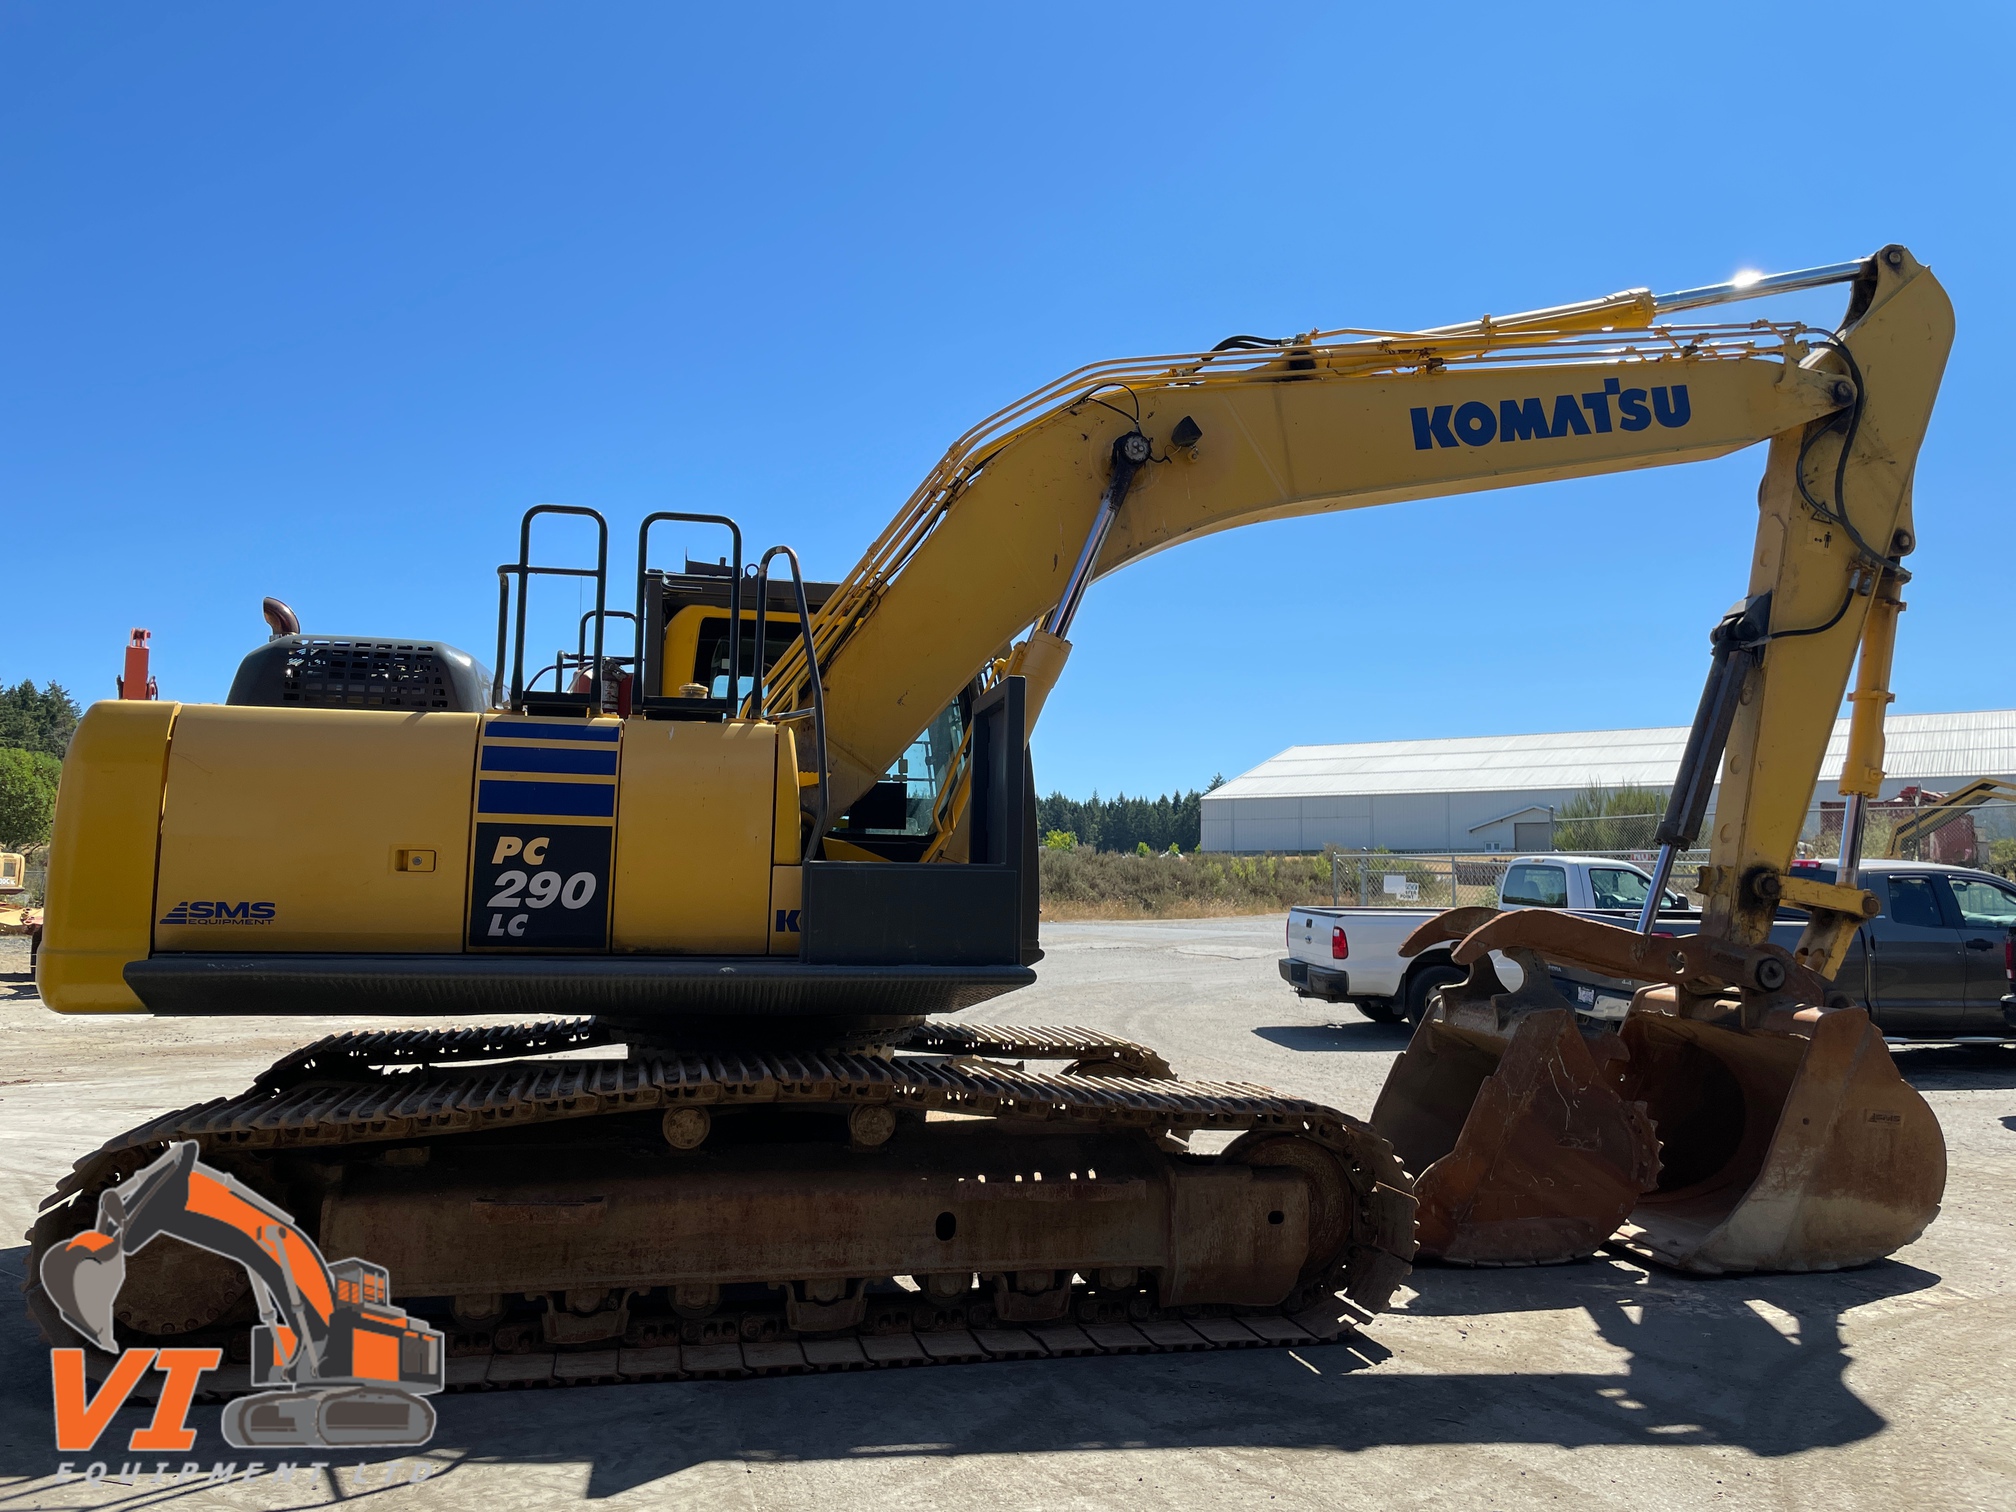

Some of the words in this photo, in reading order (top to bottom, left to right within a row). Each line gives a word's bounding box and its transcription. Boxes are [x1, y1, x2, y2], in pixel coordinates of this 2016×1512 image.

[1409, 377, 1692, 451] KOMATSU
[491, 836, 550, 866] PC
[486, 870, 597, 910] 290
[188, 901, 276, 919] SMS
[487, 913, 529, 937] LC
